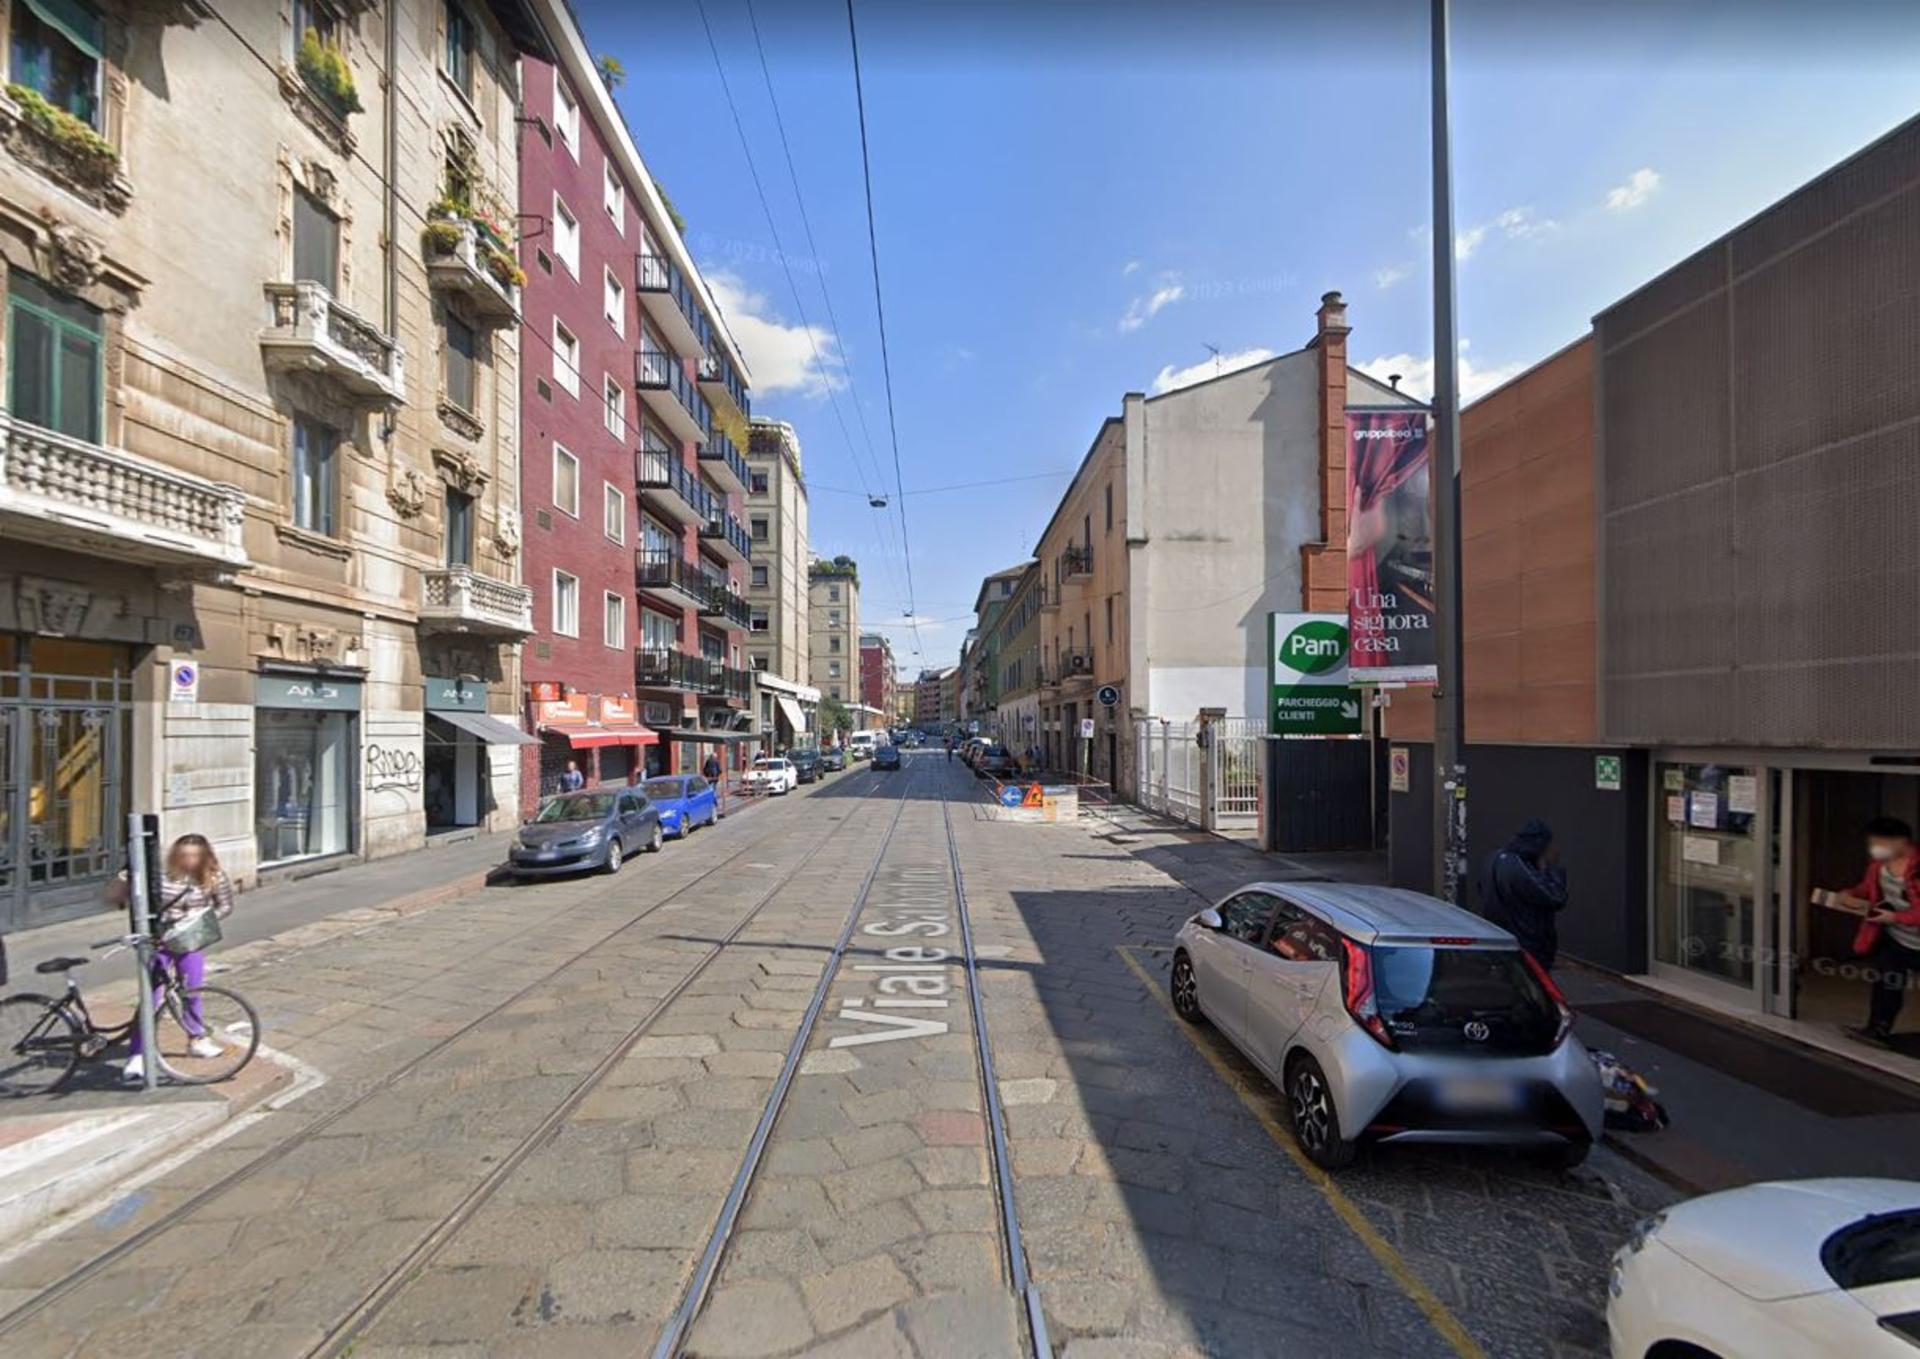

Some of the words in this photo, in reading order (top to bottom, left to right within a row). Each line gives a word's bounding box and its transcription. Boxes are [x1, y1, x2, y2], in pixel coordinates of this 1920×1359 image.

[1355, 588, 1397, 609] Una
[1353, 611, 1429, 637] signora
[1291, 634, 1340, 656] Pam
[1354, 636, 1400, 652] casa
[1278, 698, 1340, 708] PARCHEGGIO
[1278, 710, 1316, 721] CLIENTI
